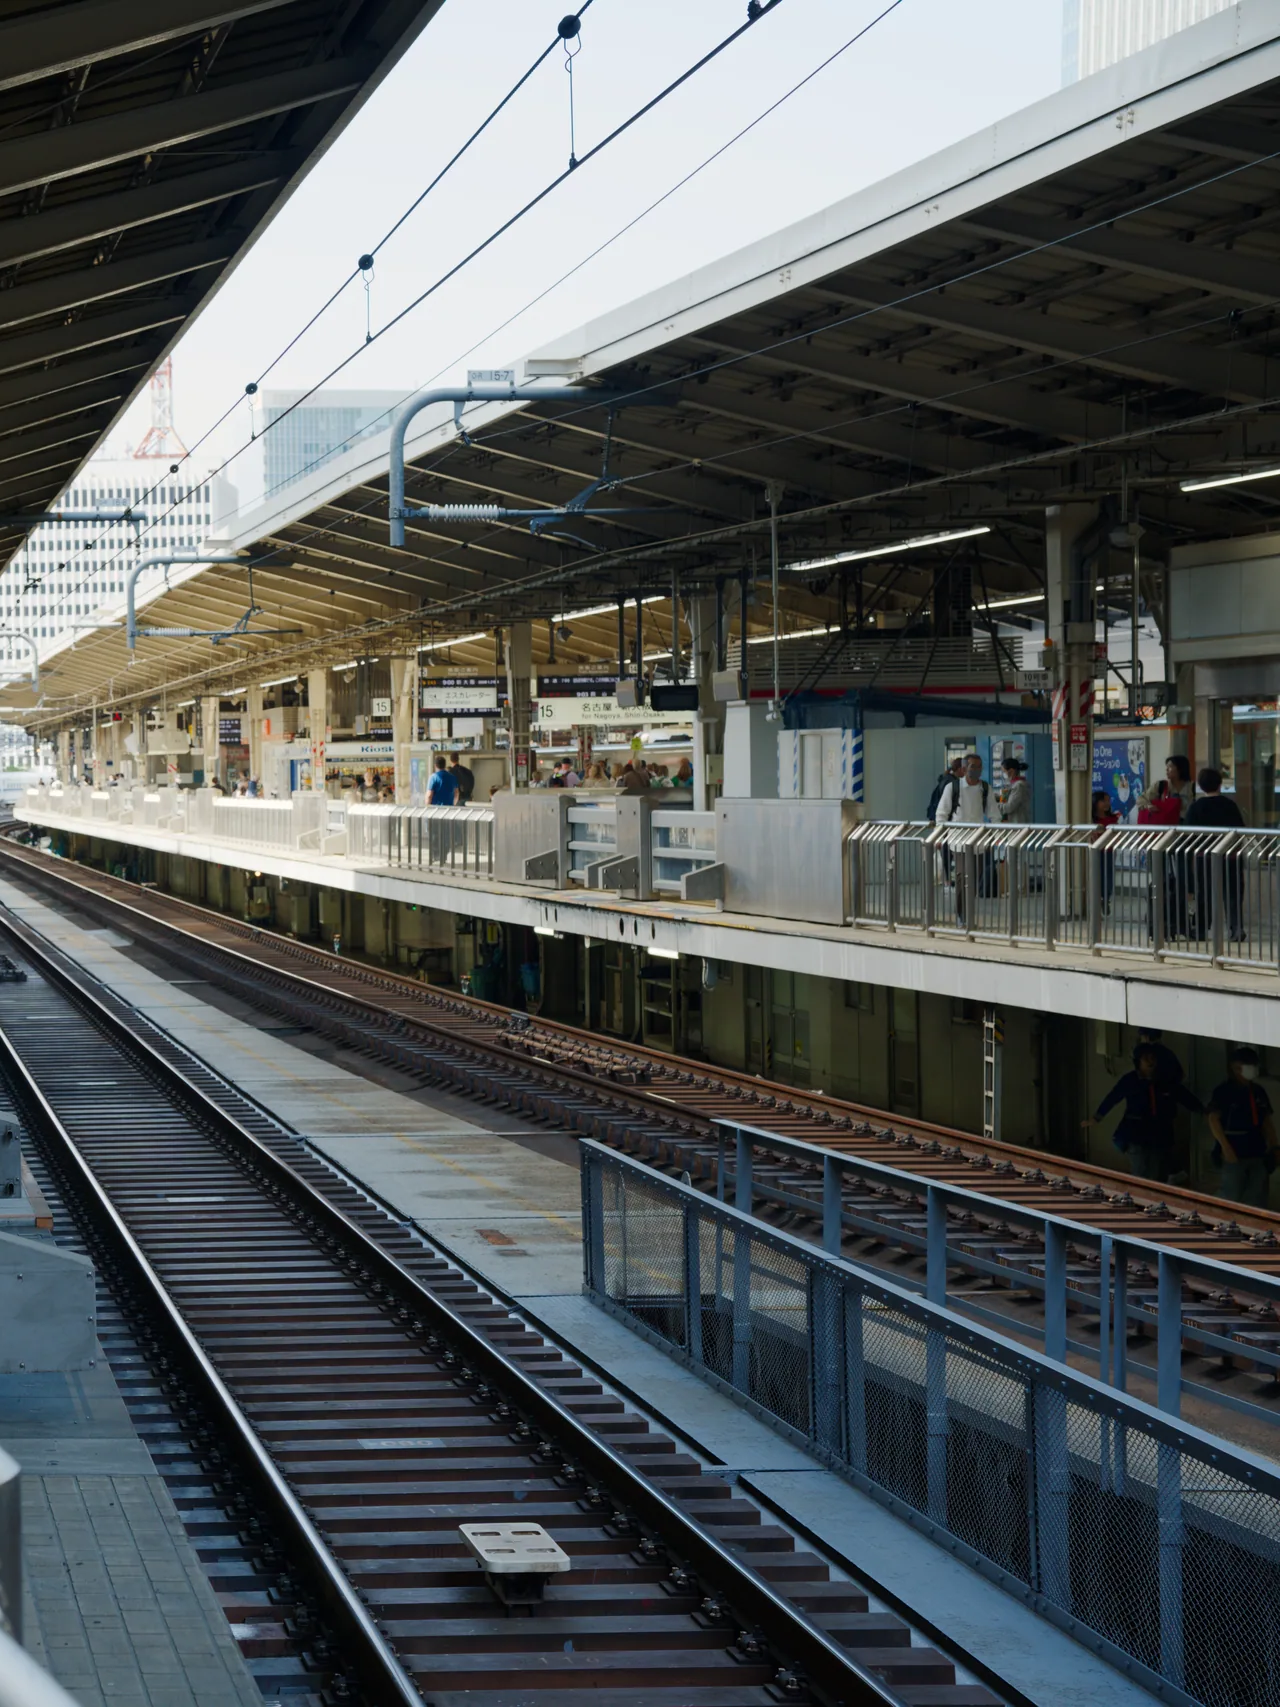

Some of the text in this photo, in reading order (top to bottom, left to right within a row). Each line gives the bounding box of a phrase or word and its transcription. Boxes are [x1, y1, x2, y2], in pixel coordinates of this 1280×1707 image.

[376, 701, 387, 712] 15
[539, 704, 553, 718] 15
[1099, 745, 1113, 757] One
